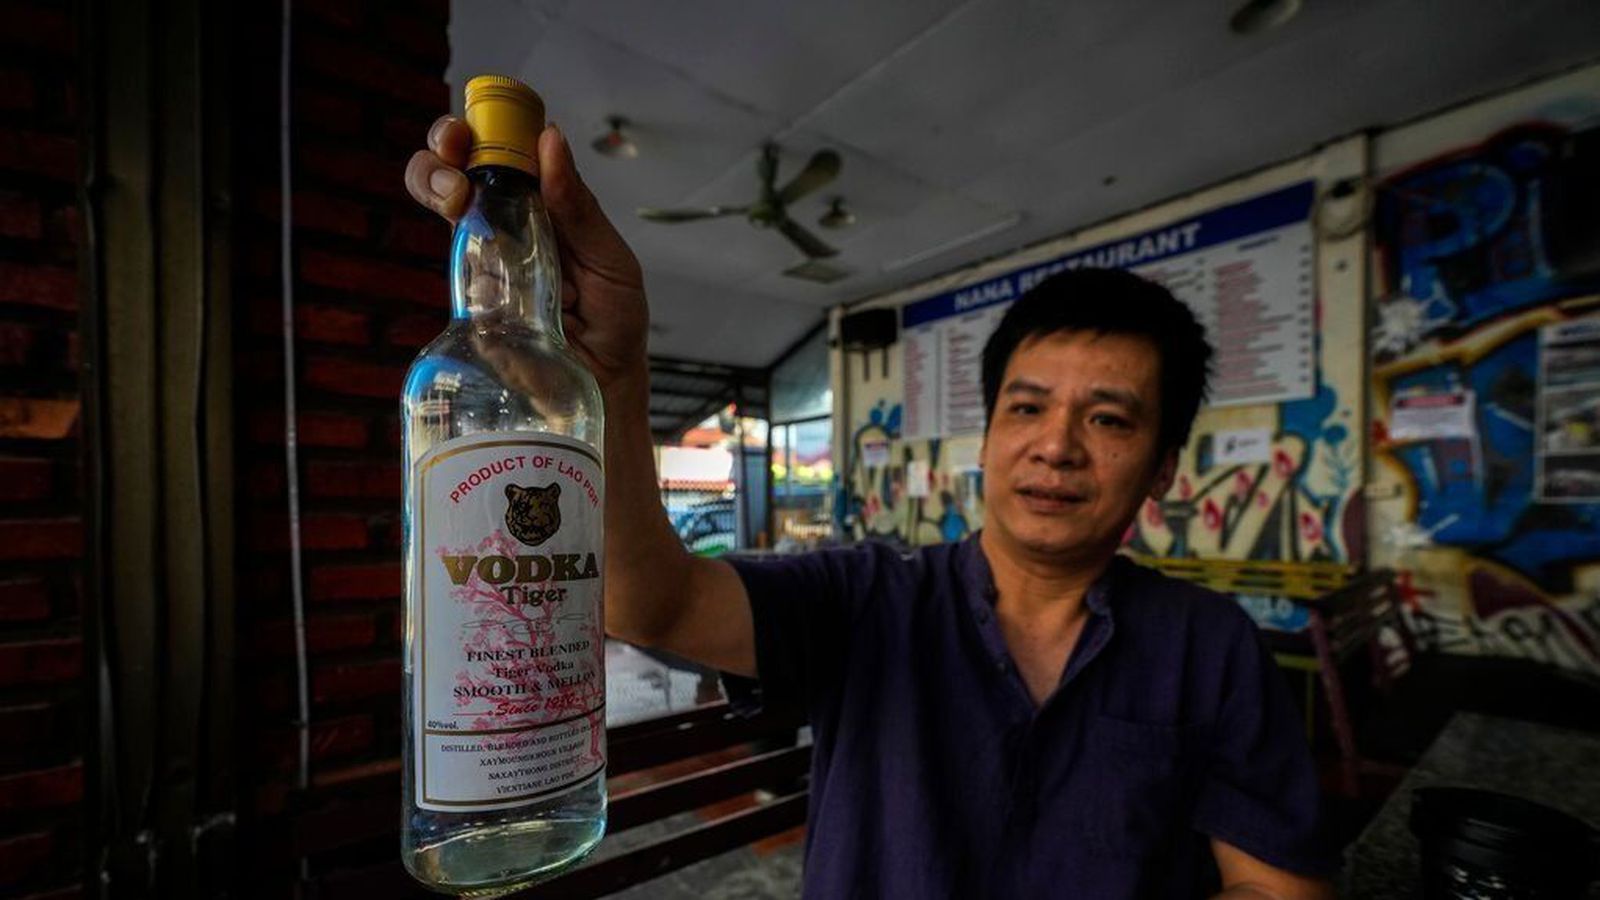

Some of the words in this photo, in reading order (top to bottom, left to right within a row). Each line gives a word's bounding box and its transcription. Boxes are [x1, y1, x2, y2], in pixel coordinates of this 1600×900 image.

[954, 284, 1014, 312] NANA
[450, 457, 525, 503] PRODUCT
[532, 455, 554, 469] OF
[557, 461, 583, 483] LAO
[442, 553, 599, 584] VODKA
[499, 586, 568, 607] Tiger
[466, 650, 527, 663] FINEST
[530, 640, 590, 659] BLENDED
[492, 667, 532, 680] Tiger
[536, 661, 574, 674] Vodka
[453, 683, 527, 698] SMOOTH
[530, 681, 543, 693] &
[494, 700, 539, 716] Since
